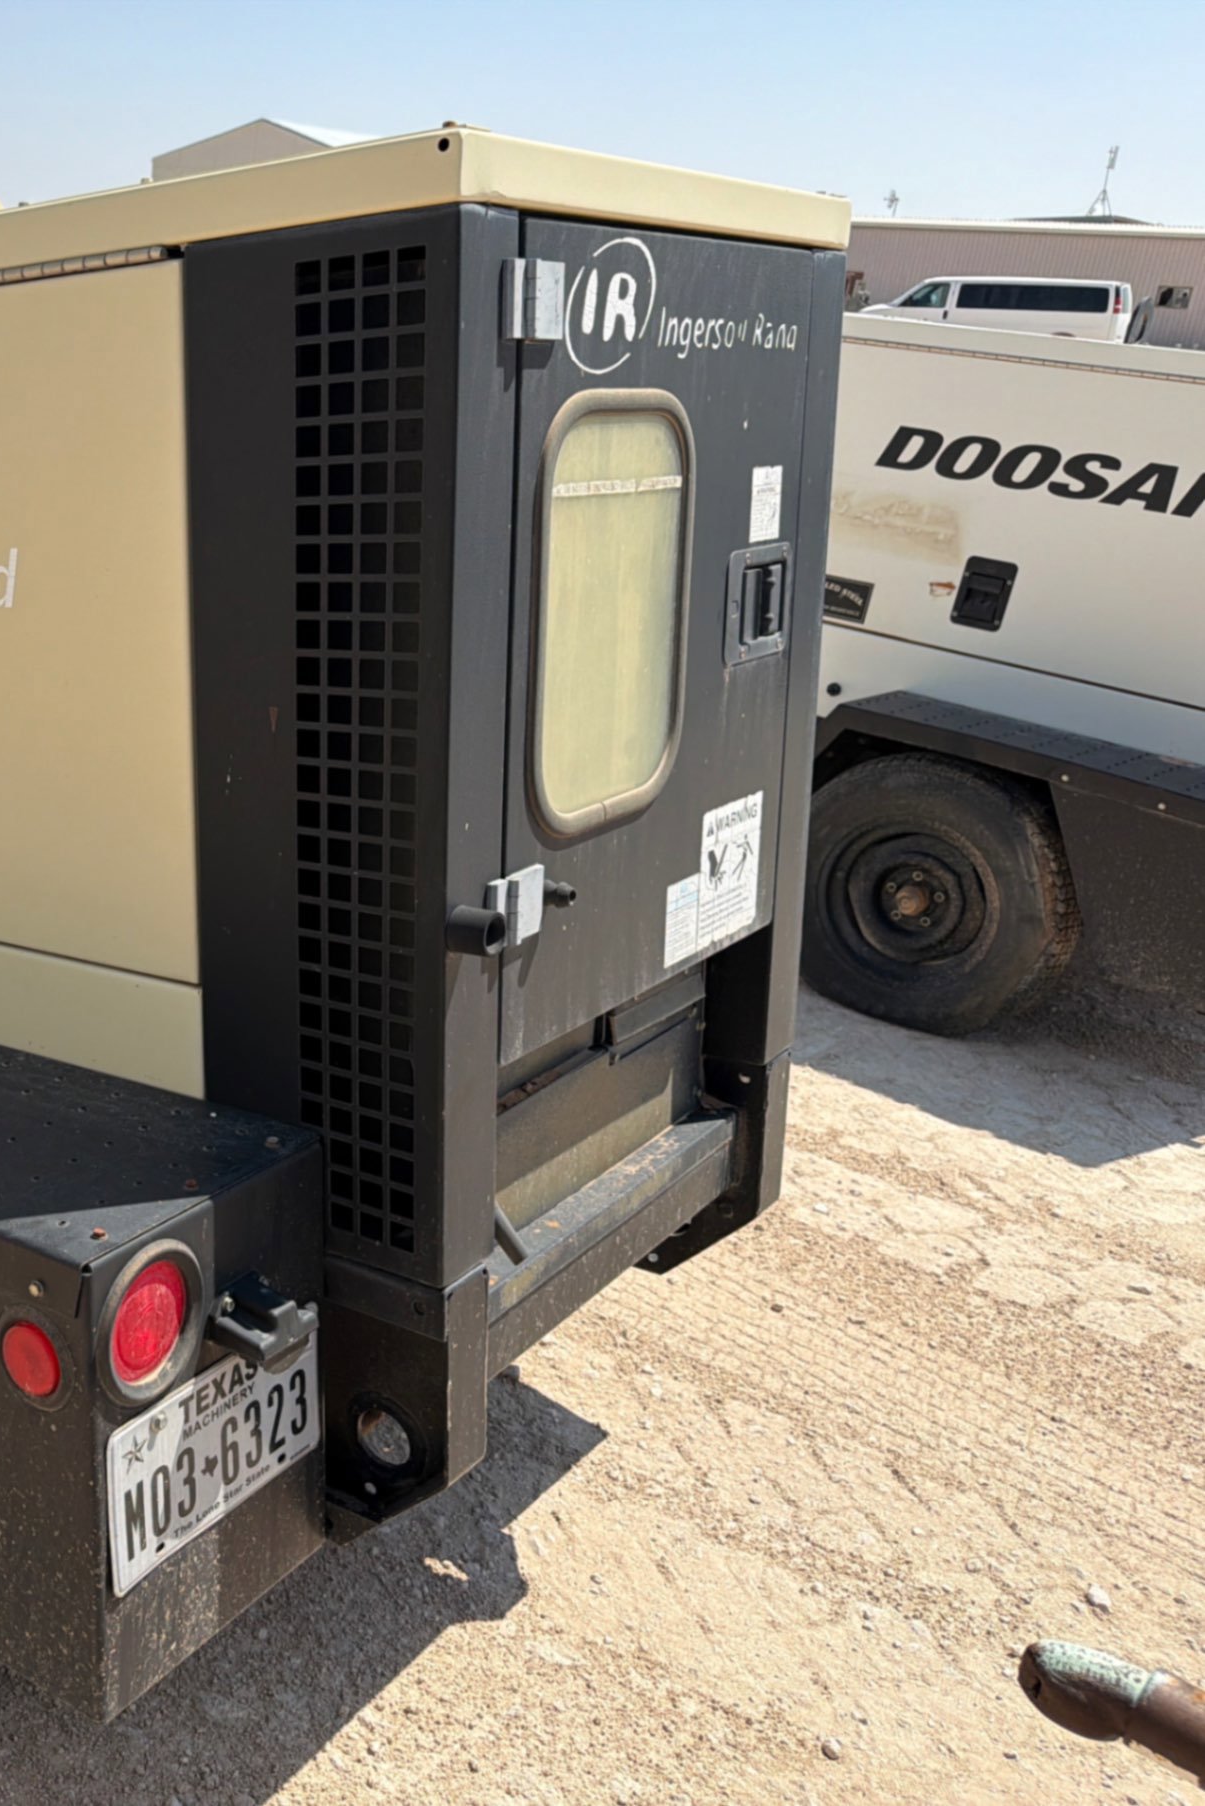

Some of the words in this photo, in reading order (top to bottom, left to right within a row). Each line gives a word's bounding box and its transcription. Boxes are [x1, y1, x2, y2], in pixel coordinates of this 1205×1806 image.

[581, 267, 638, 342] IR
[716, 802, 759, 832] WARNING
[178, 1361, 258, 1424] TEXAS
[182, 1382, 255, 1441] MACHINERY
[174, 1521, 193, 1538] The
[196, 1501, 220, 1521] Lone
[223, 1484, 244, 1503] Star
[245, 1464, 271, 1487] State
